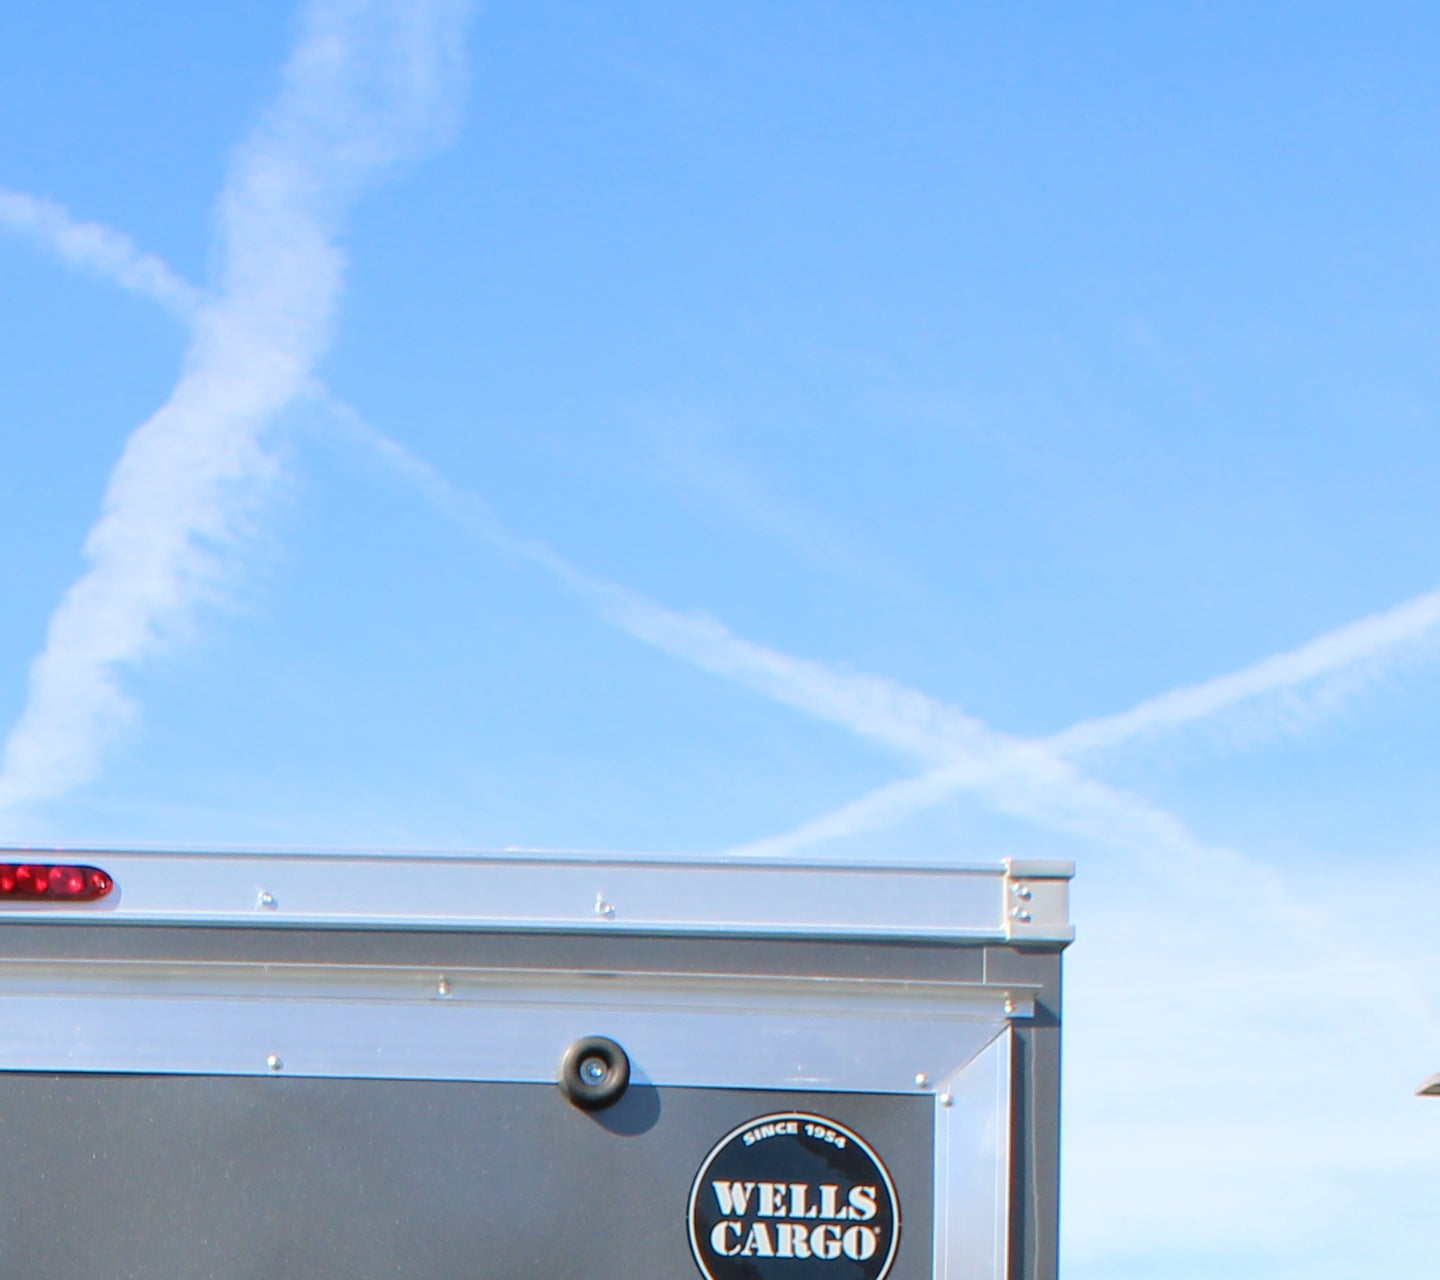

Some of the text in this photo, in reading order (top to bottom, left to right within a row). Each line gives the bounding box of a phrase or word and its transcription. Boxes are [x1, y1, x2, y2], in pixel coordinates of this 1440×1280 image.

[742, 1122, 847, 1149] SINCE 1954
[711, 1180, 878, 1221] WELLS
[710, 1220, 878, 1261] CARGO
